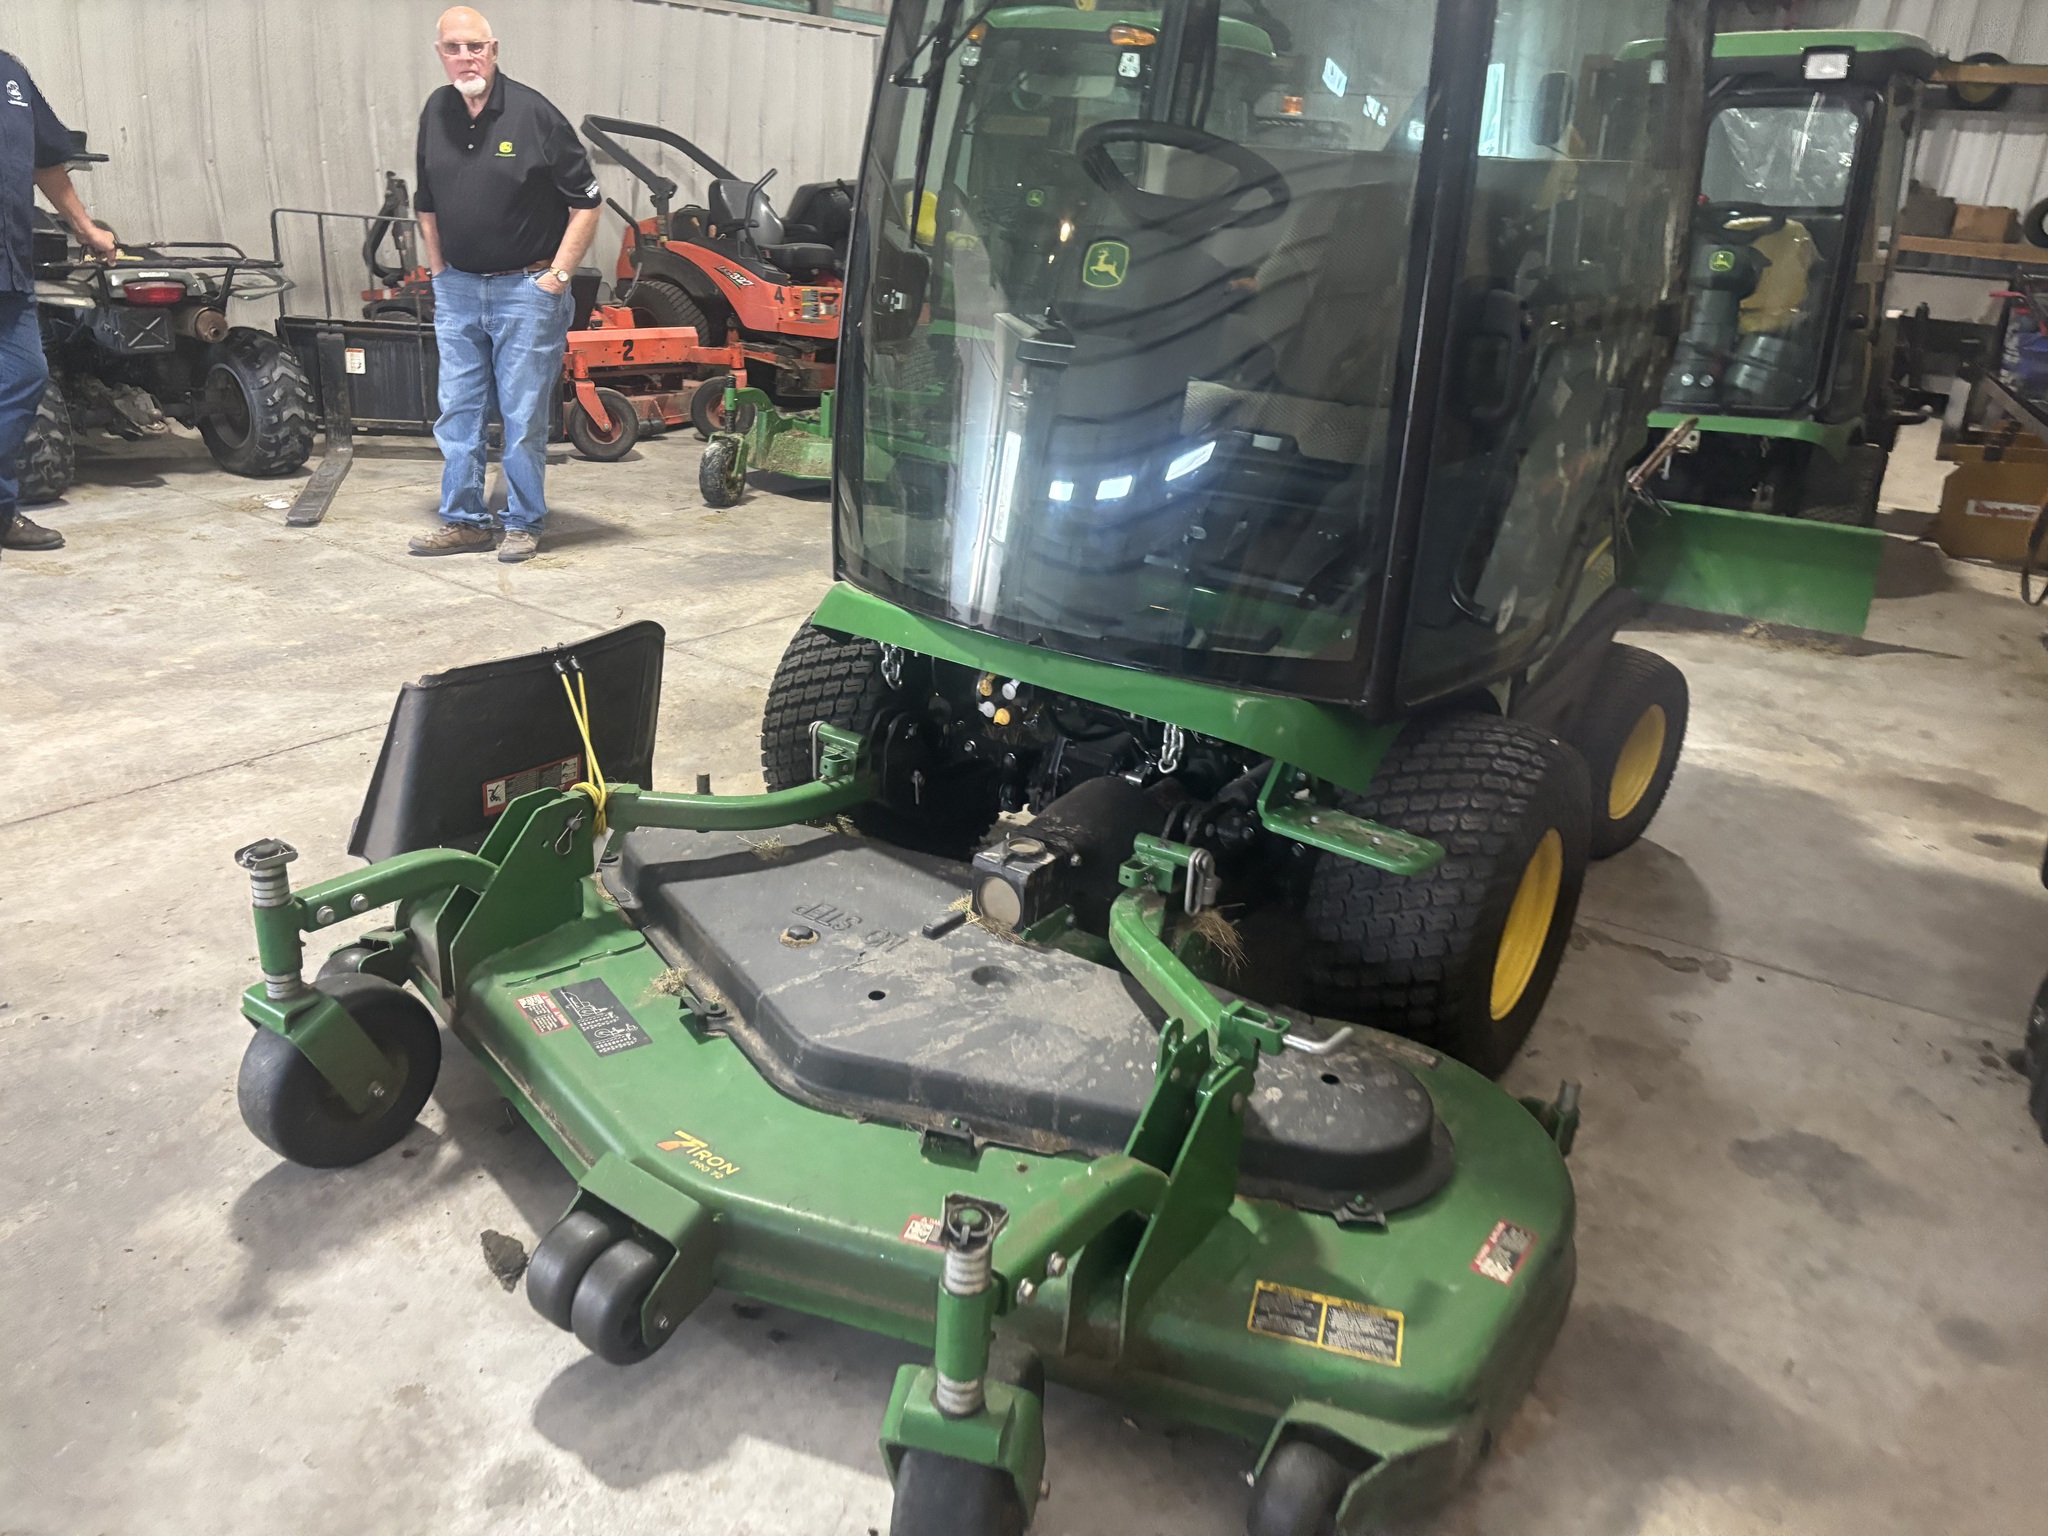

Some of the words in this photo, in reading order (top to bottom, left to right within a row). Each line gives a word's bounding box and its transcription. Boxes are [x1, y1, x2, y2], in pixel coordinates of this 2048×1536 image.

[774, 286, 785, 305] 4
[622, 338, 635, 361] 2
[791, 902, 863, 931] STEP
[863, 928, 909, 953] NO
[689, 1159, 710, 1172] PRO
